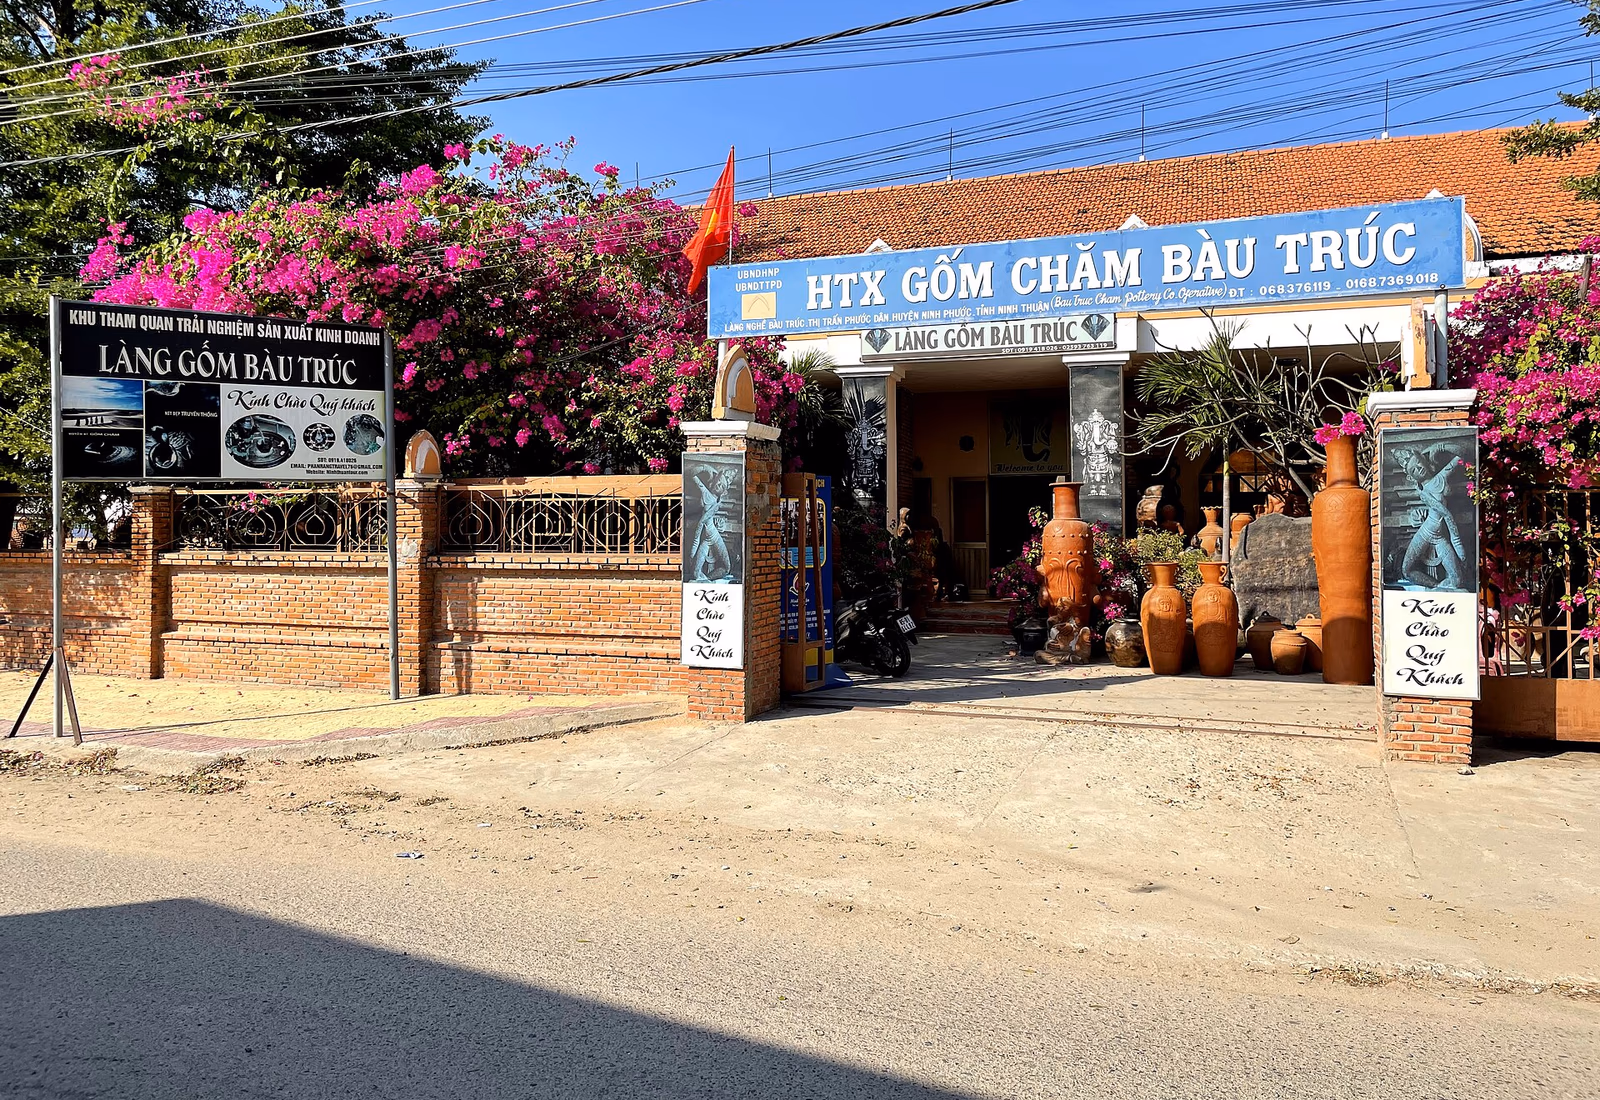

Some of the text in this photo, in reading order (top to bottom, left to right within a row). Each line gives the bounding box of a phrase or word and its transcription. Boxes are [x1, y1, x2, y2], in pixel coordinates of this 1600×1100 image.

[806, 211, 1417, 310] HTX GỐM CHĂM BÀU TRÚC
[724, 322, 744, 332] LÀNG
[746, 318, 766, 331] NGHỀ
[768, 319, 784, 330] BÀU
[823, 314, 842, 326] TRẤN
[844, 312, 871, 324] PHƯỚC
[922, 310, 940, 320] NINH
[998, 304, 1018, 314] NINH
[1020, 300, 1050, 313] THUẬN
[1073, 294, 1093, 306] Truc
[1095, 292, 1122, 304] Cham
[1260, 281, 1331, 296] 068.376.119
[1346, 272, 1439, 289] 0168.7369.018
[69, 309, 380, 346] KHU THAM QUAN TRẢI NGHIỆM SẢN XUẤT KINH DOANH
[894, 326, 938, 352] LÀNG
[990, 321, 1025, 346] BÀU
[1030, 317, 1078, 344] TRÚC
[98, 339, 358, 385] LÀNG GỐM BÀU TRÚC
[227, 390, 376, 416] Kính Chào Quý khách
[995, 464, 1064, 472] Welcome to you
[694, 590, 729, 604] Kính
[696, 607, 725, 620] Chào
[1400, 598, 1457, 618] Kính
[696, 626, 723, 644] Quý
[1405, 621, 1450, 638] Chào
[690, 644, 734, 660] Khách
[1406, 644, 1446, 666] Quý
[1396, 668, 1465, 686] Khách
